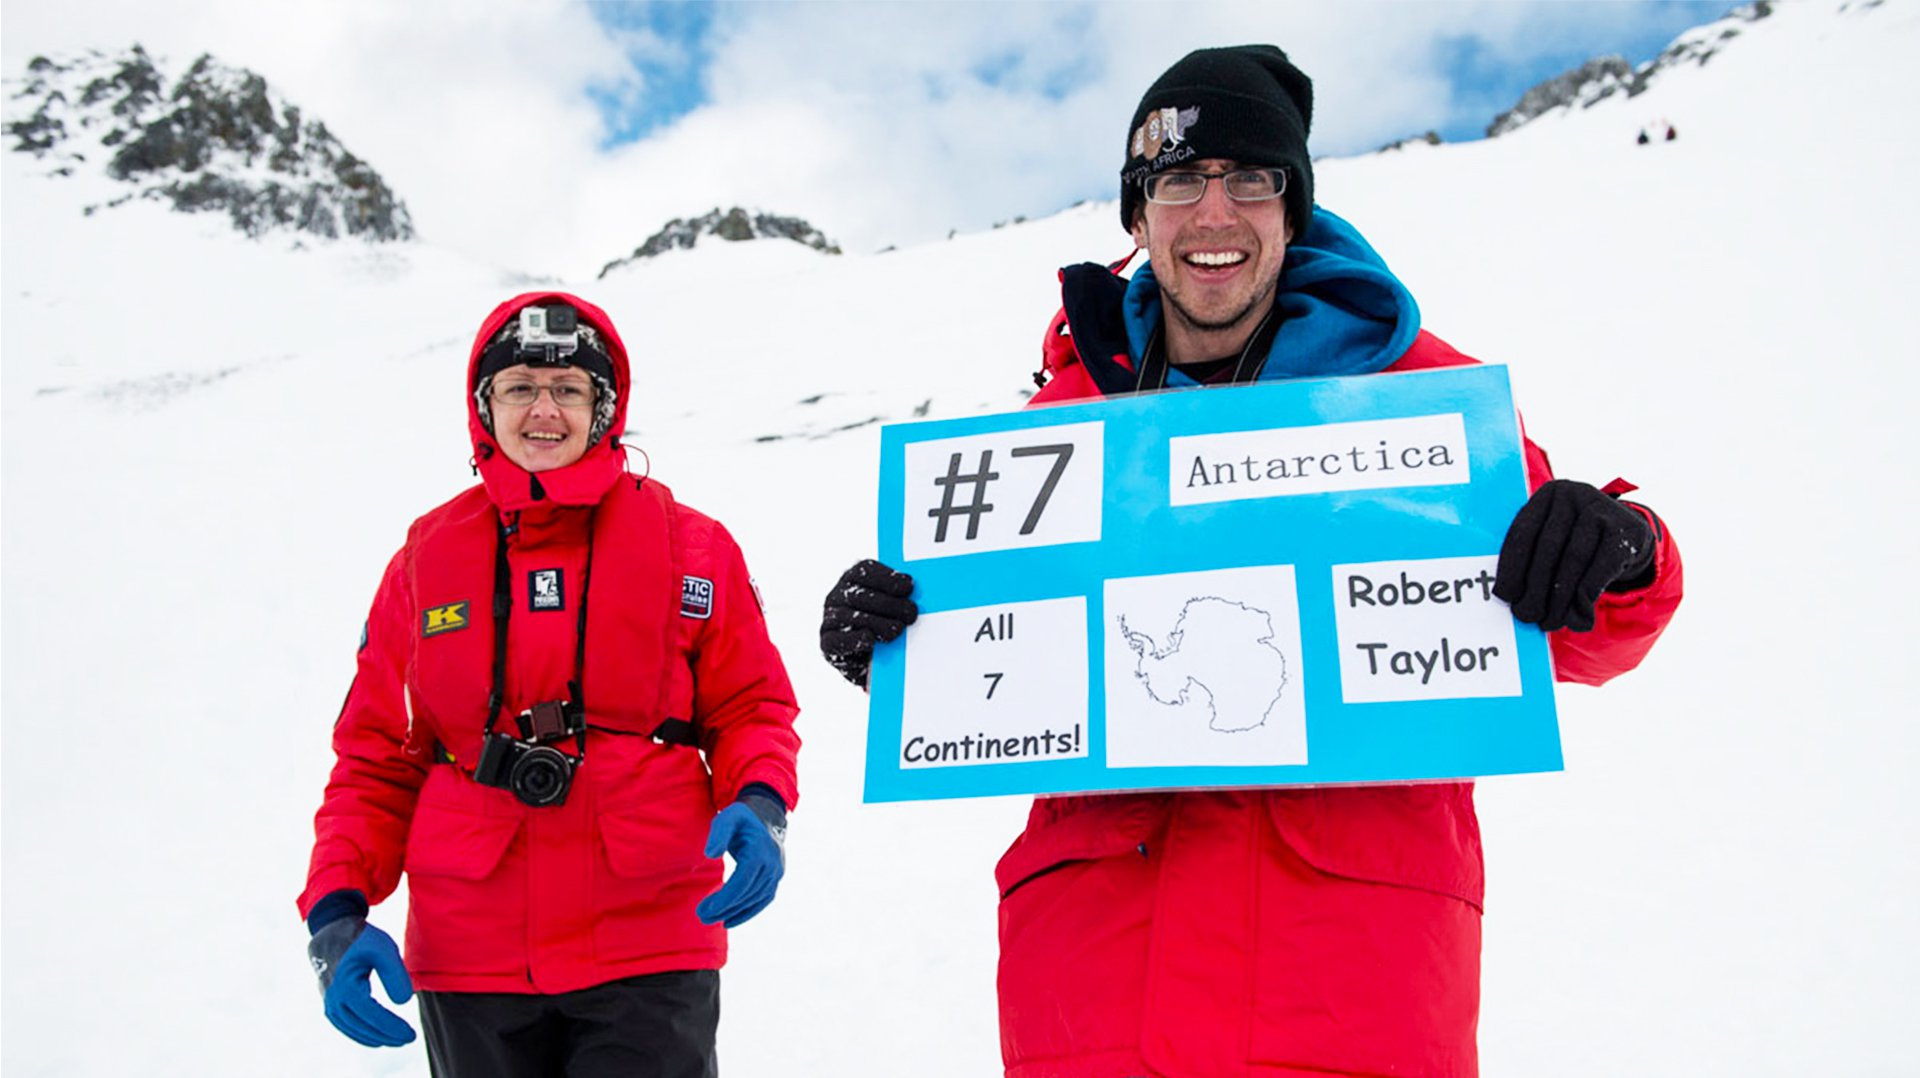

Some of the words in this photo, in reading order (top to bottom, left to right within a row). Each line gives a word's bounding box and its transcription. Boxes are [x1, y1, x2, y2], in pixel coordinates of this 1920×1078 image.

[1152, 145, 1196, 172] AFRICA
[1187, 443, 1456, 488] Antarctica
[928, 443, 1074, 543] #7
[1348, 569, 1496, 608] Robert
[426, 603, 465, 628] K
[974, 612, 1014, 643] All
[1356, 637, 1499, 685] Taylor
[984, 672, 1004, 700] 7
[903, 723, 1081, 763] Continents!
